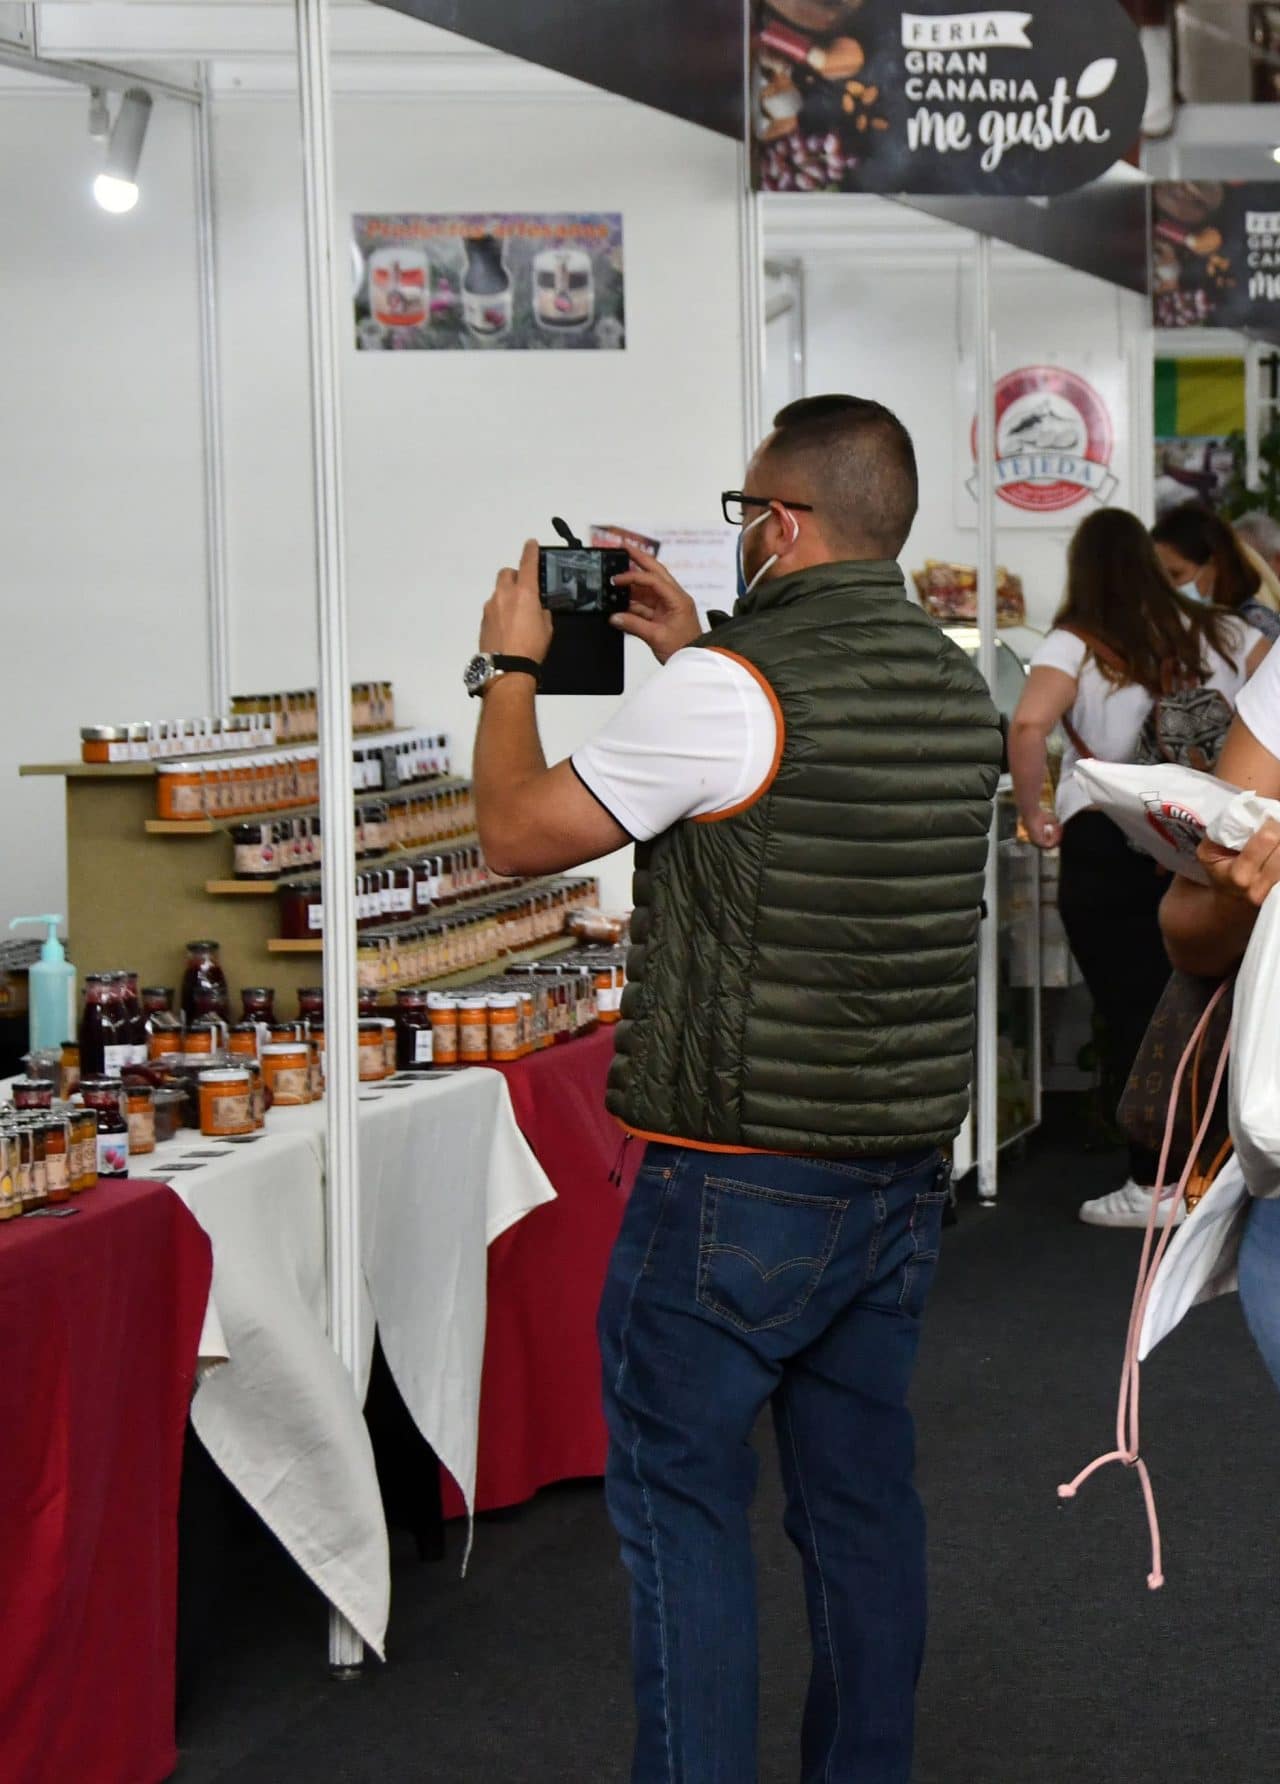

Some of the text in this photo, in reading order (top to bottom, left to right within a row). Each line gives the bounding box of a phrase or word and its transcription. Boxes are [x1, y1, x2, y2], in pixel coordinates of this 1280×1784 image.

[912, 22, 1000, 41] FERIA
[905, 51, 988, 75] GRAN
[905, 78, 1039, 102] CANARIA
[907, 77, 1110, 173] me gusta
